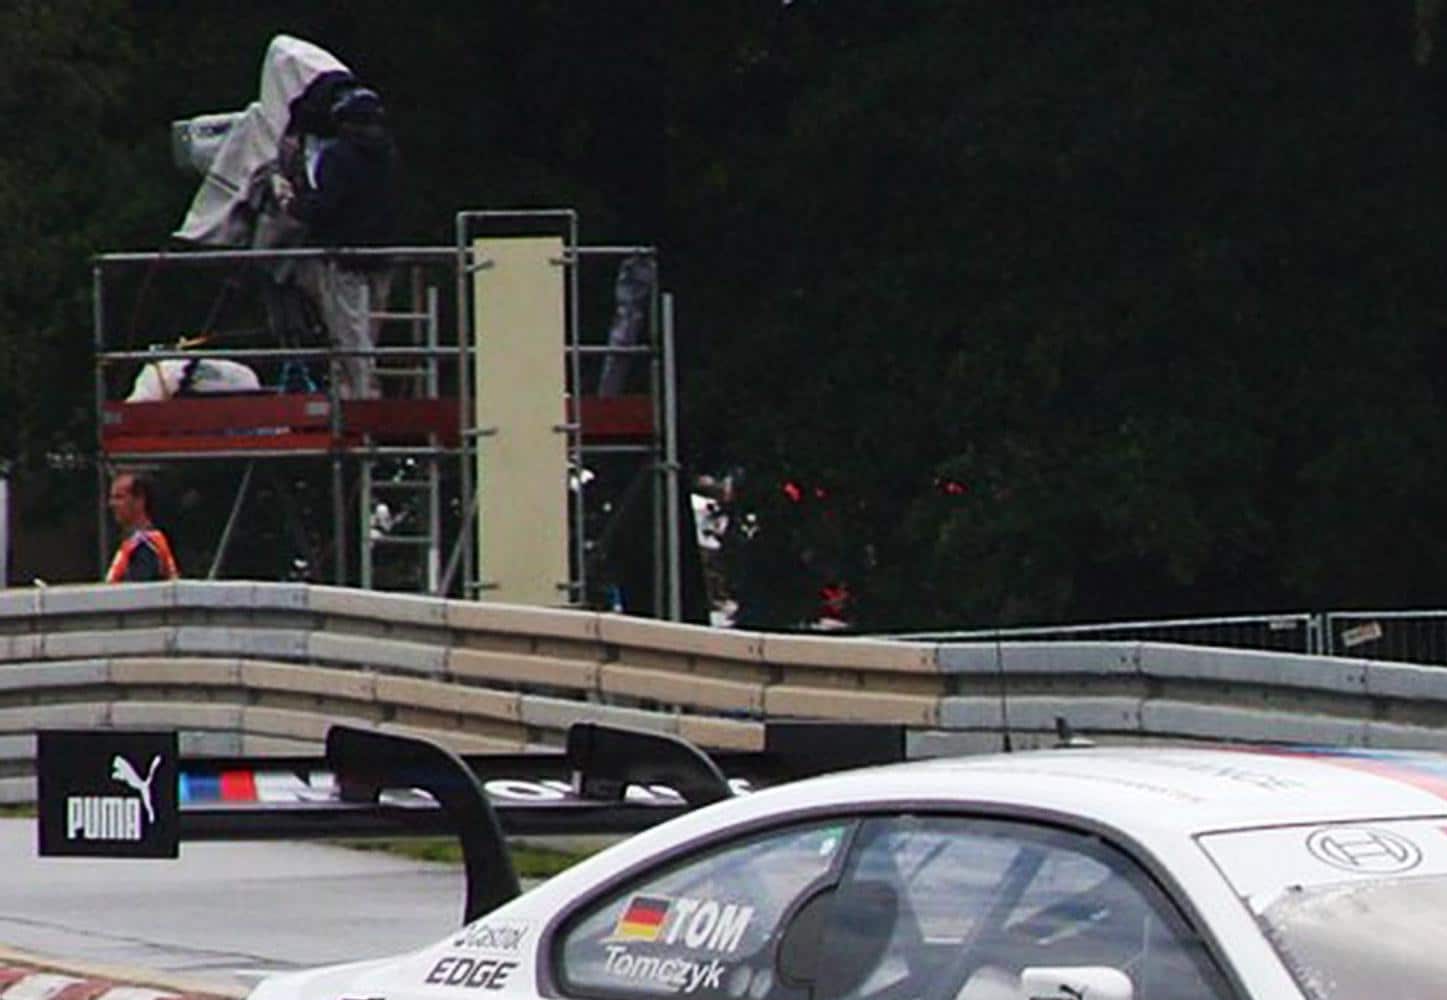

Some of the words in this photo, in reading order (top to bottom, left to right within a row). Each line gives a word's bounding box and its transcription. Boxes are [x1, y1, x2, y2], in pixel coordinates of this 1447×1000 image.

[67, 797, 141, 839] PUMA
[665, 898, 755, 953] TOM
[425, 957, 519, 989] EDGE
[604, 945, 726, 994] Tomczyk
